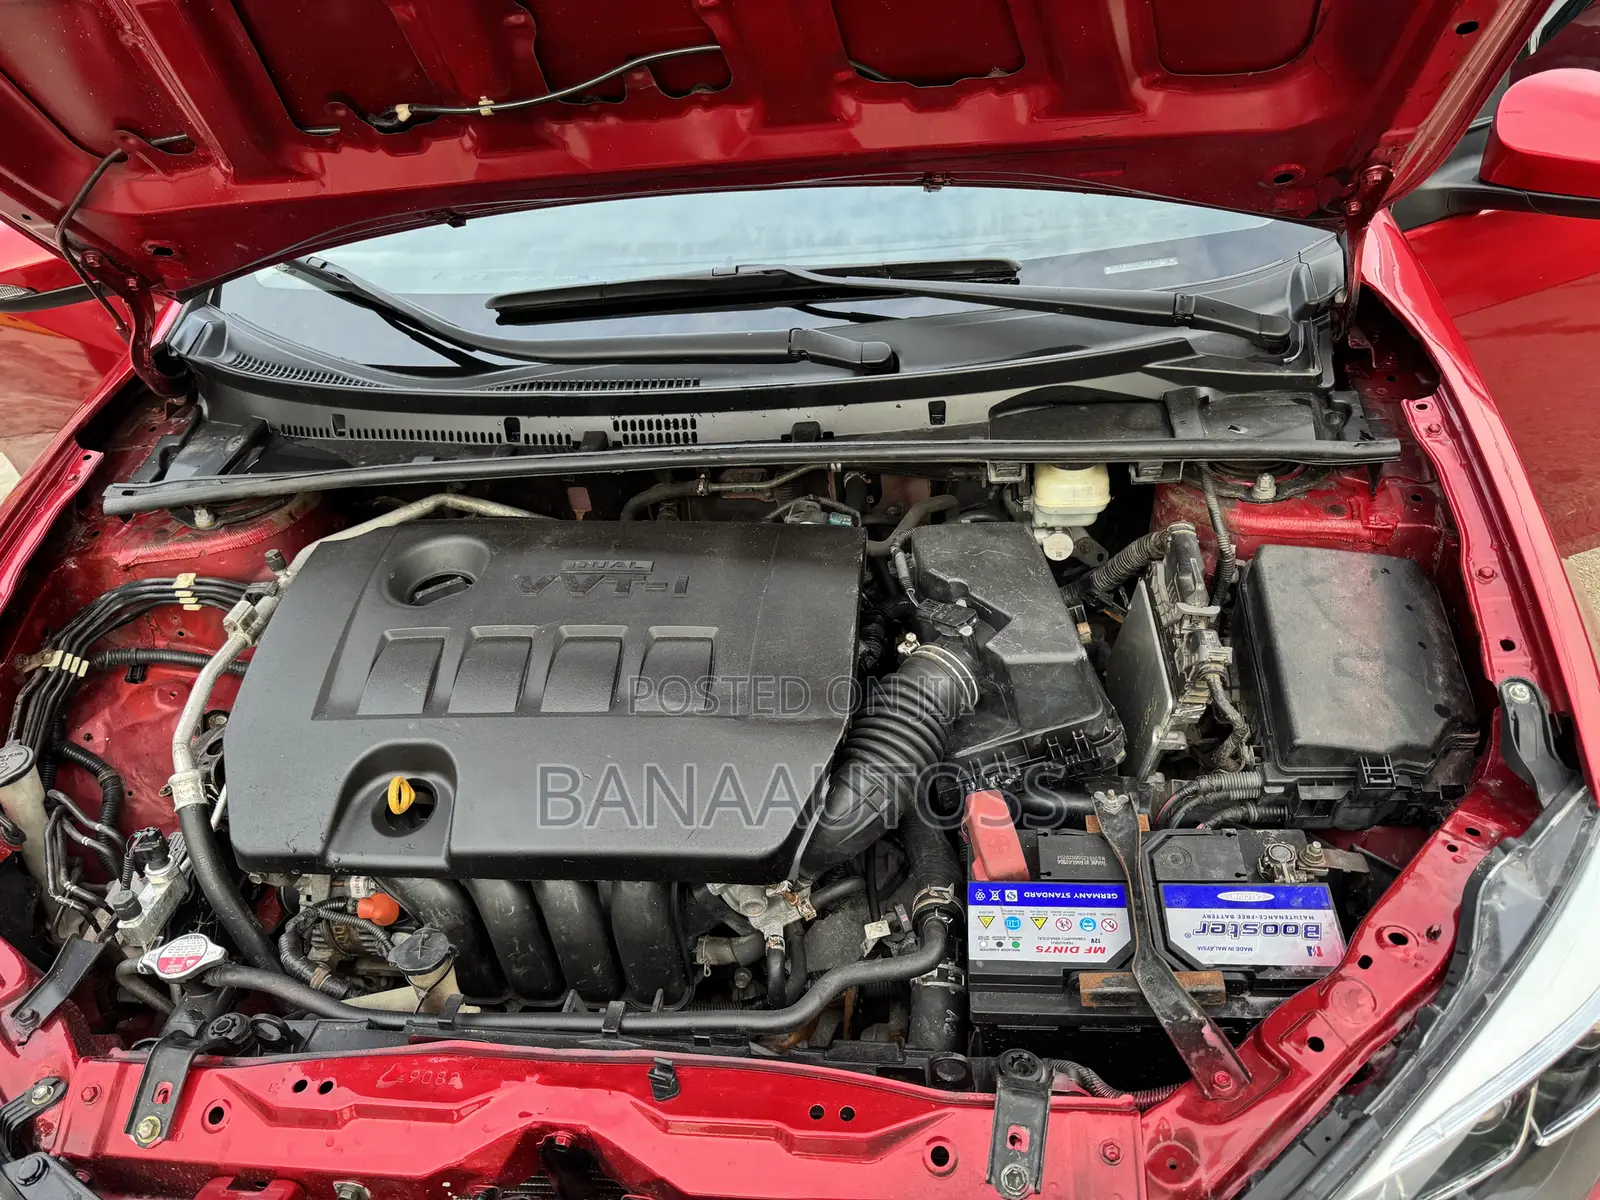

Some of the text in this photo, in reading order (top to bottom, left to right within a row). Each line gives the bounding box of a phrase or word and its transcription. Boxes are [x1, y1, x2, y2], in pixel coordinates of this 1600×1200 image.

[572, 561, 645, 569] DUAL
[1023, 891, 1118, 900] GERMANY STANDARD
[1035, 946, 1107, 954] MF DIN75
